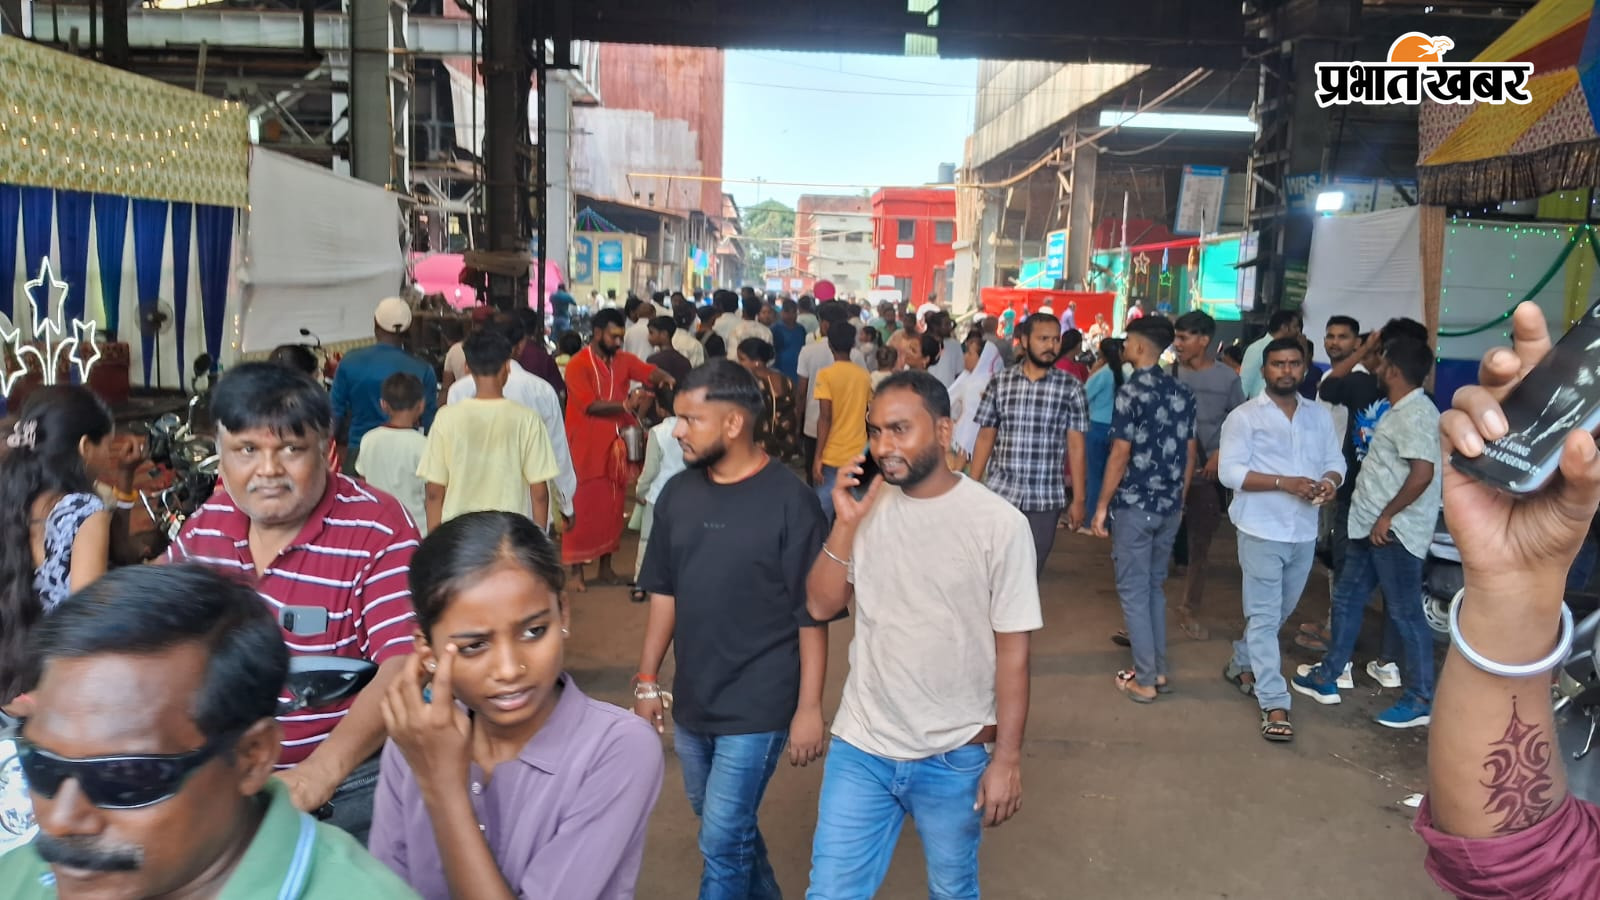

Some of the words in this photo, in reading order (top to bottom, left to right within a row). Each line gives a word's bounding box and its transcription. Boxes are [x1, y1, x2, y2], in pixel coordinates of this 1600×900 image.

[1286, 175, 1317, 195] WRS
[1506, 441, 1531, 457] KING
[1496, 451, 1531, 471] LEGEND
